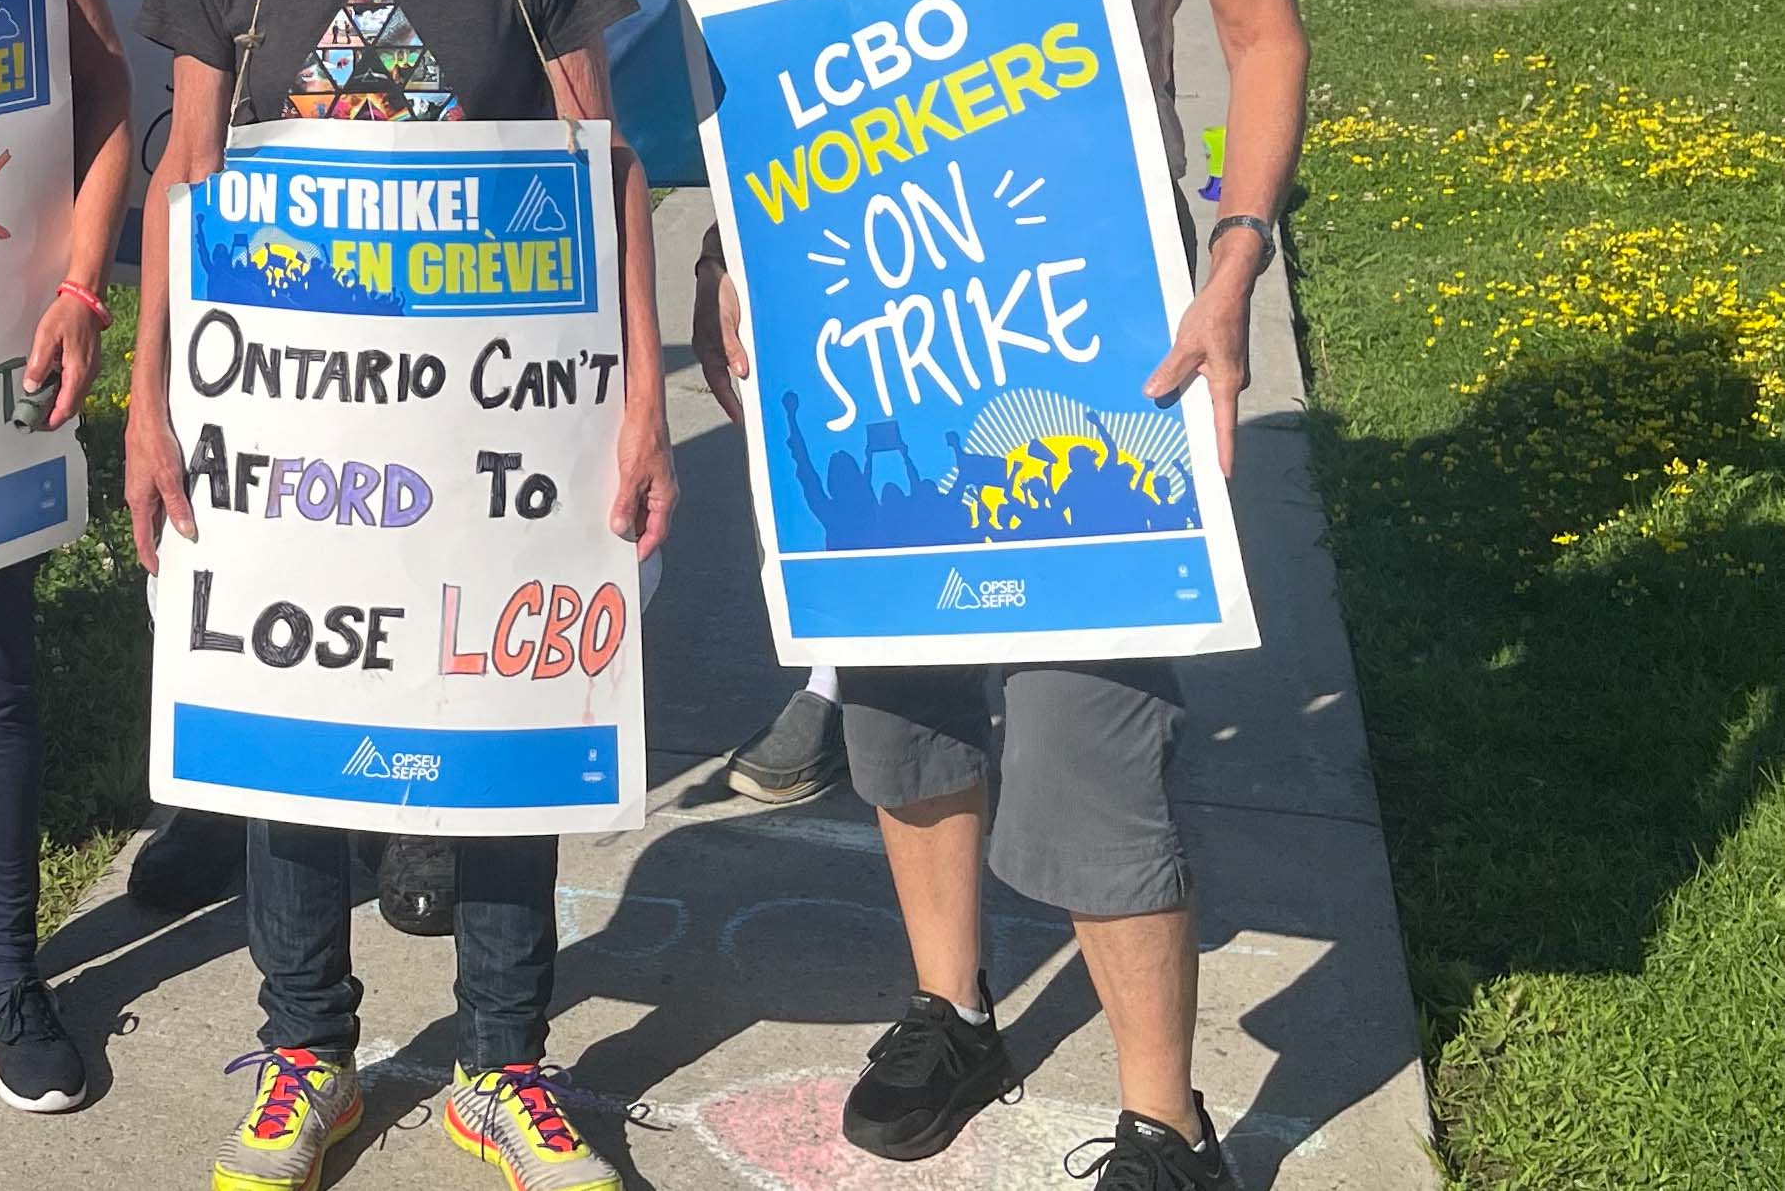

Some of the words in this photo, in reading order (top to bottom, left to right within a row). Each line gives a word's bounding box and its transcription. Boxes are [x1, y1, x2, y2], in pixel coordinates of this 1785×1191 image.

[745, 22, 1099, 224] WORKERS
[219, 171, 278, 225] ON
[289, 175, 480, 230] STRIKE!
[864, 161, 985, 289] ON
[330, 242, 393, 293] EN
[409, 229, 573, 294] GRÈVE!
[816, 257, 1100, 431] STRIKE
[185, 423, 433, 529] AFFORD
[979, 579, 1026, 595] OPSEU
[981, 593, 1026, 608] SEFPO
[190, 568, 405, 671] LOSE
[442, 580, 626, 680] LCBO
[391, 767, 439, 781] SEFPO
[392, 753, 441, 768] OPSEU
